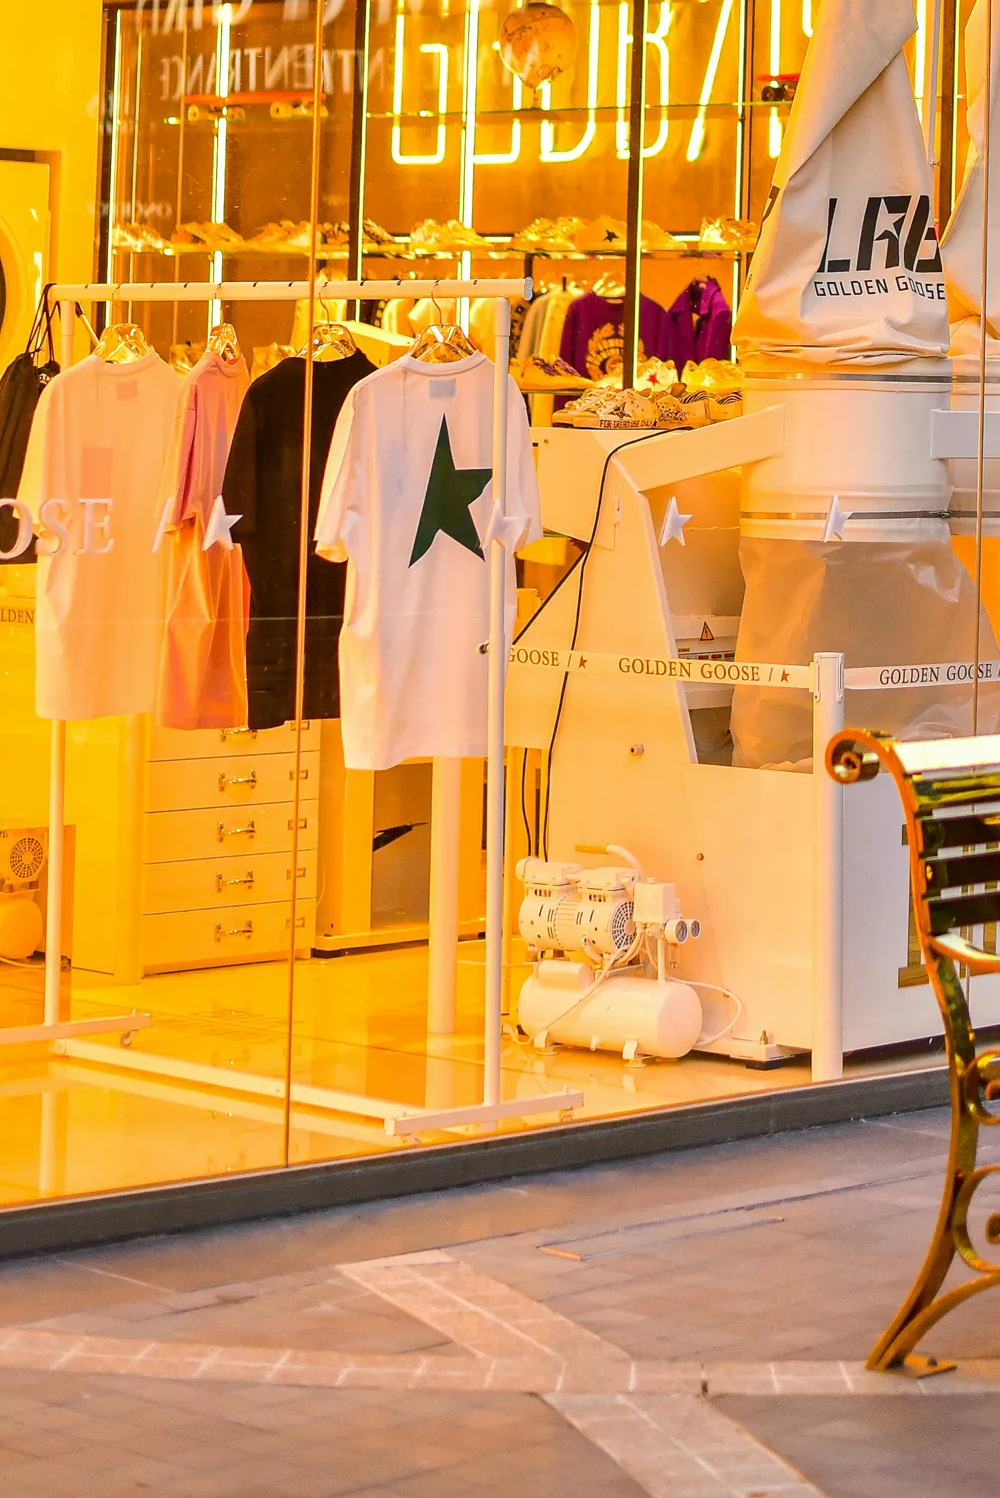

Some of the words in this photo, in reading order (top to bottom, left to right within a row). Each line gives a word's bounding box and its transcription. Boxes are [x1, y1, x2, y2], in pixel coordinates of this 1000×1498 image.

[813, 278, 889, 297] GOLDEN
[895, 275, 946, 300] GOOSE
[509, 647, 560, 667] GOOSE
[618, 657, 692, 678] GOLDEN
[700, 662, 760, 682] GOOSE
[879, 666, 940, 686] GOLDEN
[946, 663, 992, 682] GOOSE
